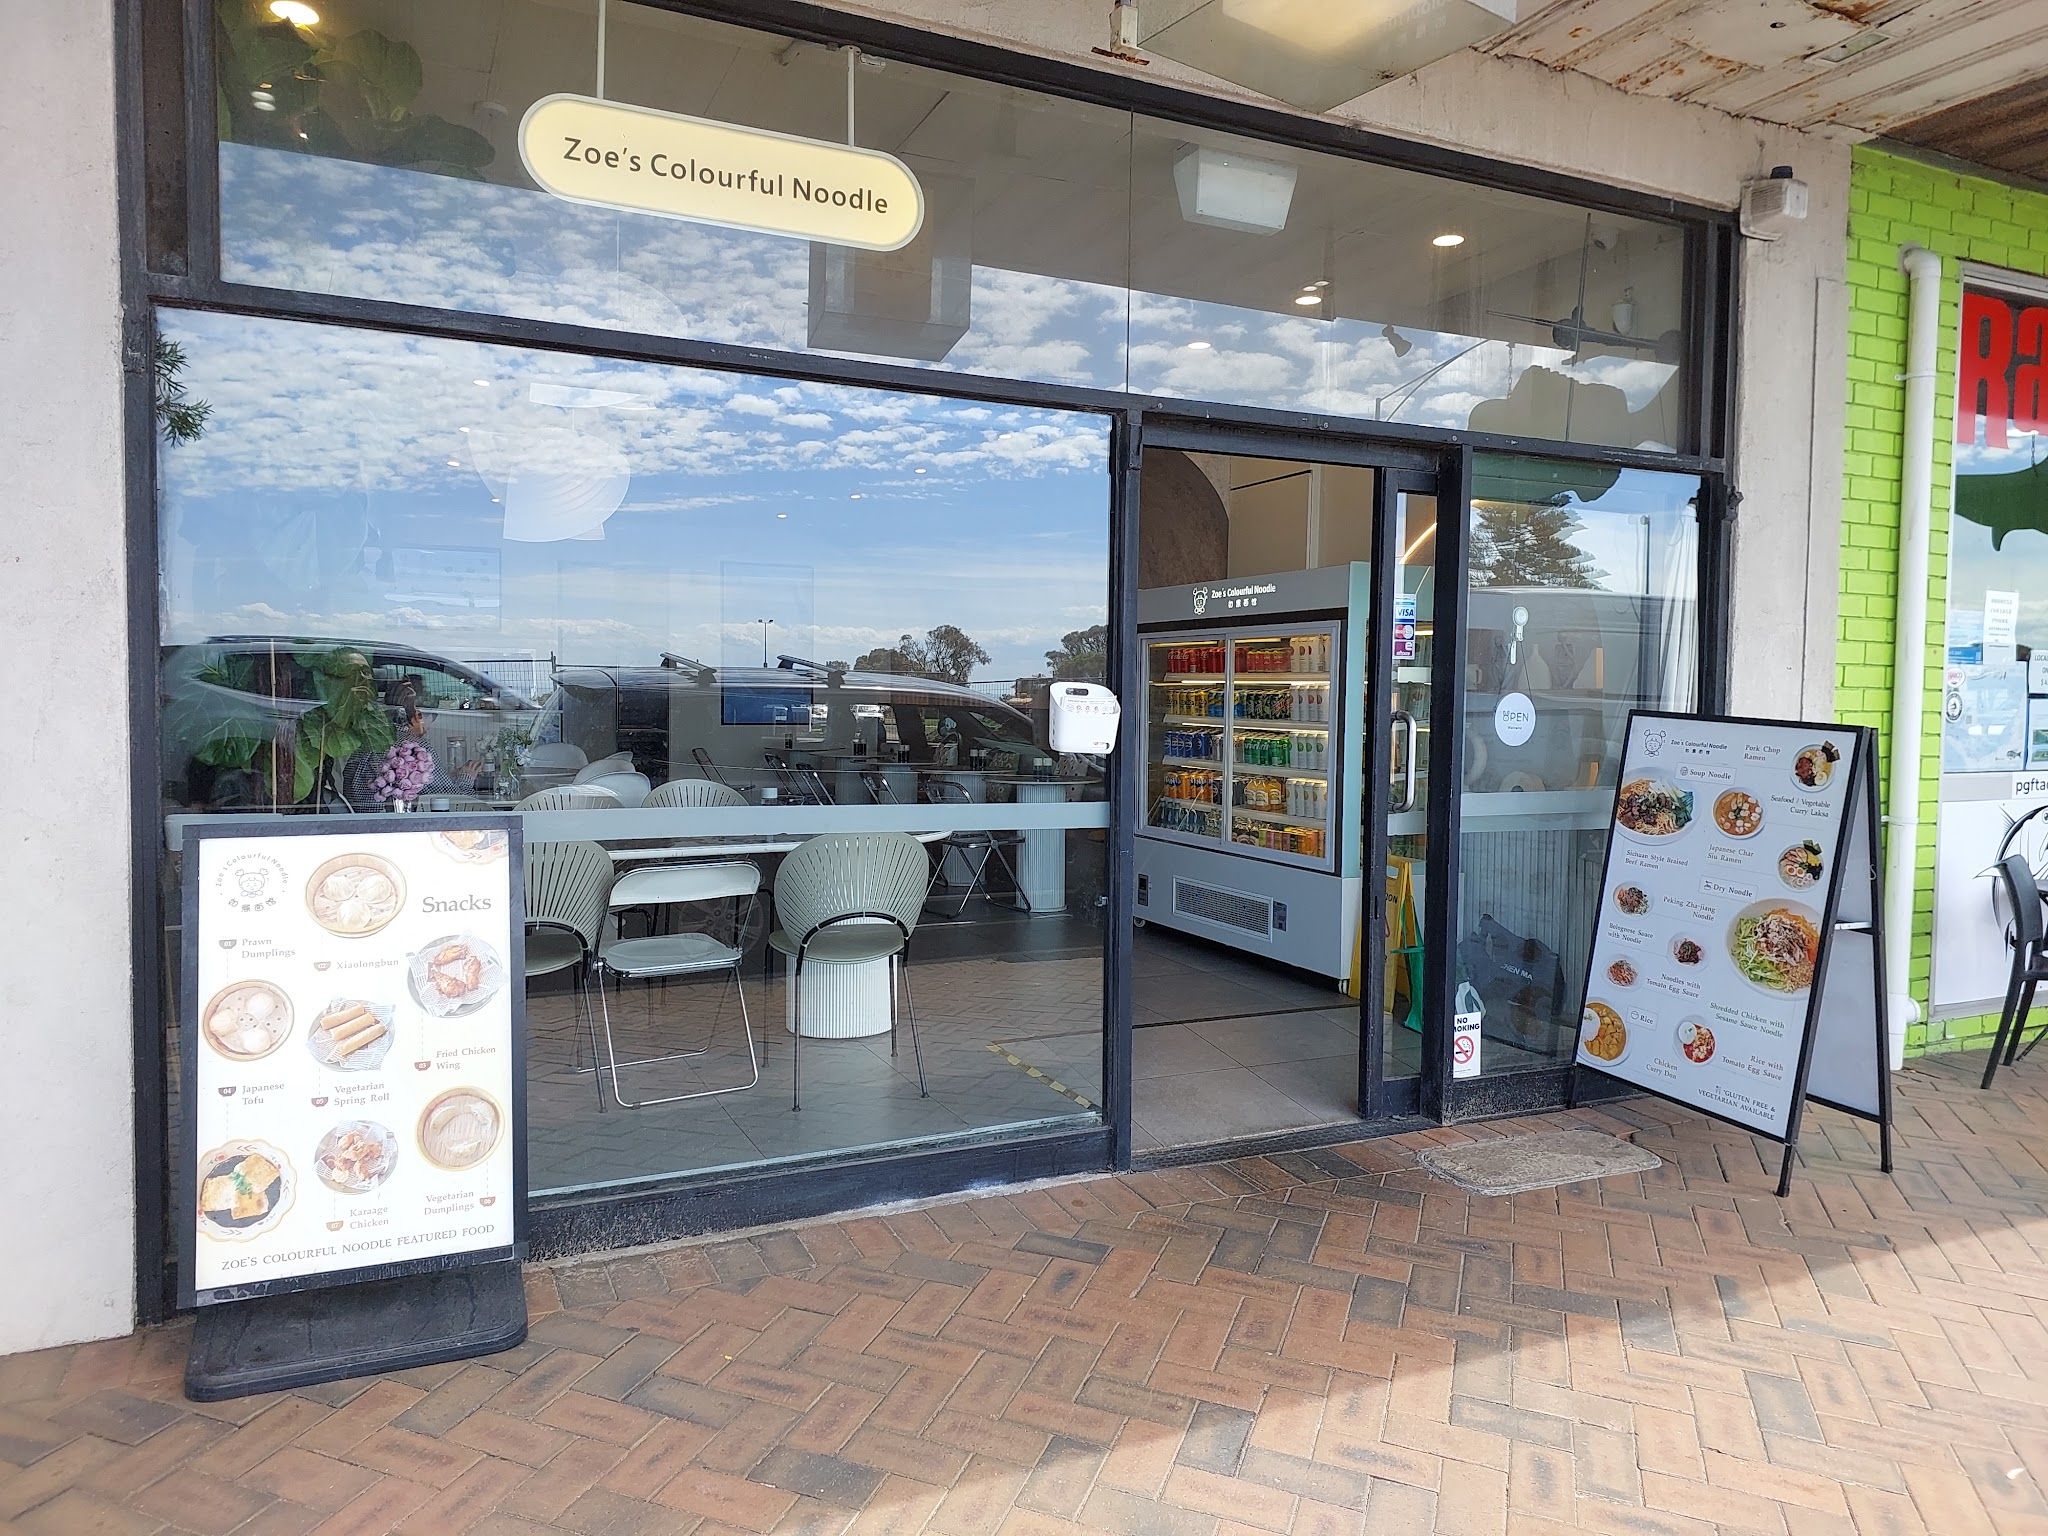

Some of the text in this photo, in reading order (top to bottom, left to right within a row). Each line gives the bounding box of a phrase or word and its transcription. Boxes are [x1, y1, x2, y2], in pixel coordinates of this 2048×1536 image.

[563, 136, 889, 214] Zoe's Colourful Noodle
[1212, 583, 1276, 598] Zoe's Colourful Noodle
[1398, 608, 1414, 616] VISA
[1744, 753, 1766, 762] Ramen
[1763, 746, 1781, 756] Chop
[1690, 768, 1732, 780] Soup Noodle
[2016, 778, 2048, 795] pgfta
[1770, 795, 1794, 804] Seafood
[1800, 799, 1831, 810] Vegetable
[1810, 808, 1829, 818] Laksa
[1650, 854, 1665, 862] Style
[1722, 854, 1742, 864] Ramen
[1640, 861, 1659, 869] Ramen
[1713, 884, 1753, 898] Dry Noodle
[422, 894, 492, 914] Snacks
[1663, 896, 1684, 908] Peking
[1693, 911, 1714, 922] Noodle
[1622, 934, 1642, 944] Noodle
[1638, 930, 1654, 938] Sauce
[241, 937, 272, 946] Prawn
[241, 948, 296, 960] Dumplings
[1662, 973, 1701, 989] Noodles with
[1647, 978, 1699, 998] Tomato Egg Sauce
[1640, 1014, 1654, 1025] Rice
[1710, 1002, 1785, 1029] Shredded Chicken with
[1454, 1023, 1480, 1032] OKING
[1715, 1013, 1783, 1038] Sesame Sauce Noodle
[436, 1046, 496, 1059] Fried Chicken
[436, 1060, 461, 1072] Wing
[1646, 1063, 1663, 1076] Curry
[1654, 1057, 1678, 1071] Chicken
[1722, 1056, 1782, 1081] Tomato Egg Sauce
[1750, 1055, 1784, 1071] Rice with
[242, 1082, 285, 1095] Japanese
[334, 1081, 385, 1095] Vegetarian
[242, 1095, 264, 1106] Tofu
[334, 1093, 390, 1108] Spring Roll
[1698, 1089, 1775, 1120] VEGETARIAN AVAILABLE
[1752, 1100, 1768, 1110] FREE
[425, 1190, 474, 1204] Vegetarian
[349, 1205, 388, 1219] Karaage
[423, 1203, 475, 1216] Dumplings
[349, 1218, 389, 1230] Chicken
[221, 1224, 495, 1272] ZOE'S COLOURFUL NOODLE FEATURED FOOD
